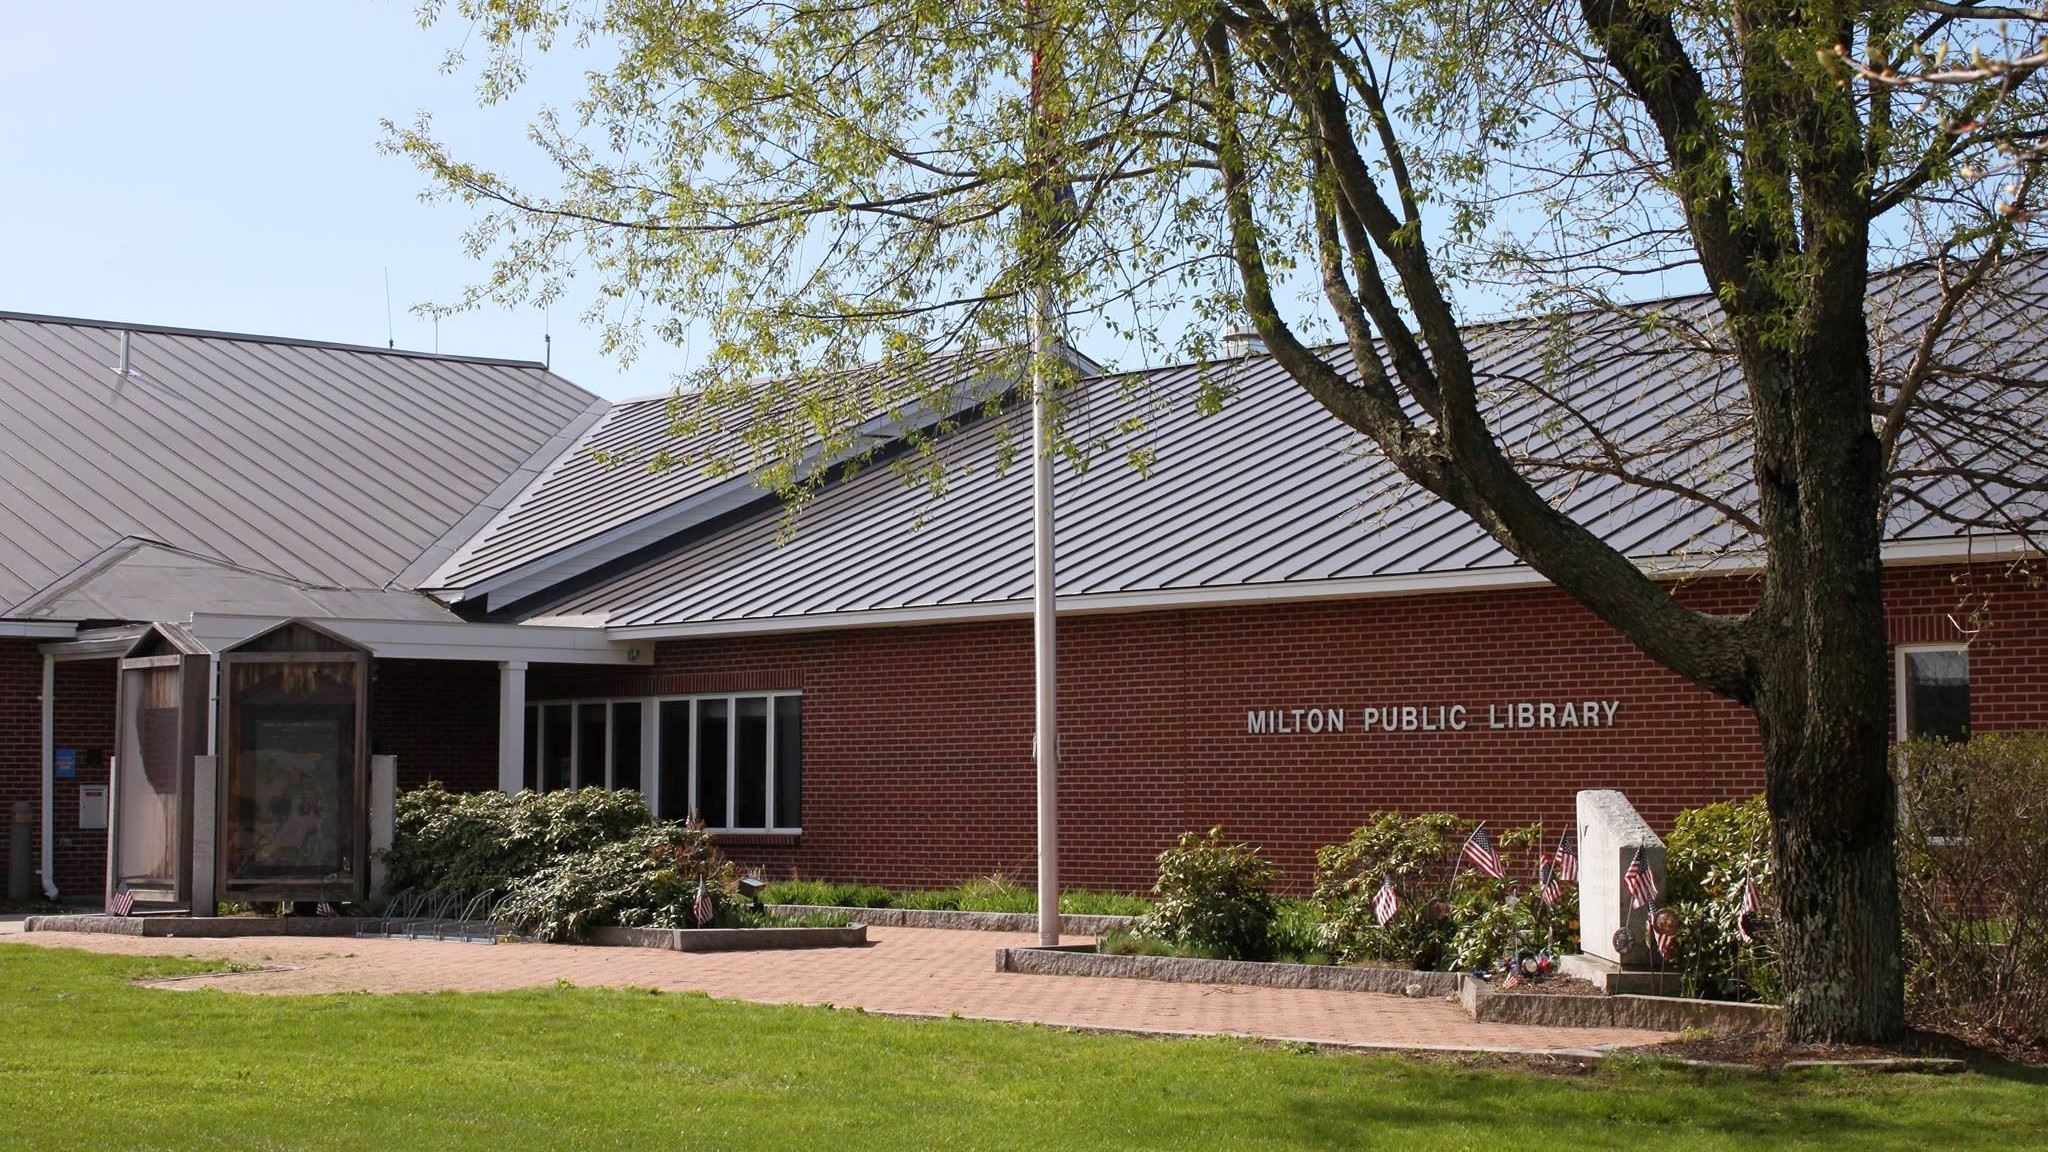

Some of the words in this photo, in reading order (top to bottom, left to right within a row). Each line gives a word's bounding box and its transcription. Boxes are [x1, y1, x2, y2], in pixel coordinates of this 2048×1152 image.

[1247, 708, 1344, 734] MILTON
[1364, 704, 1467, 732] PUBLIC
[1489, 700, 1620, 729] LIBRARY
